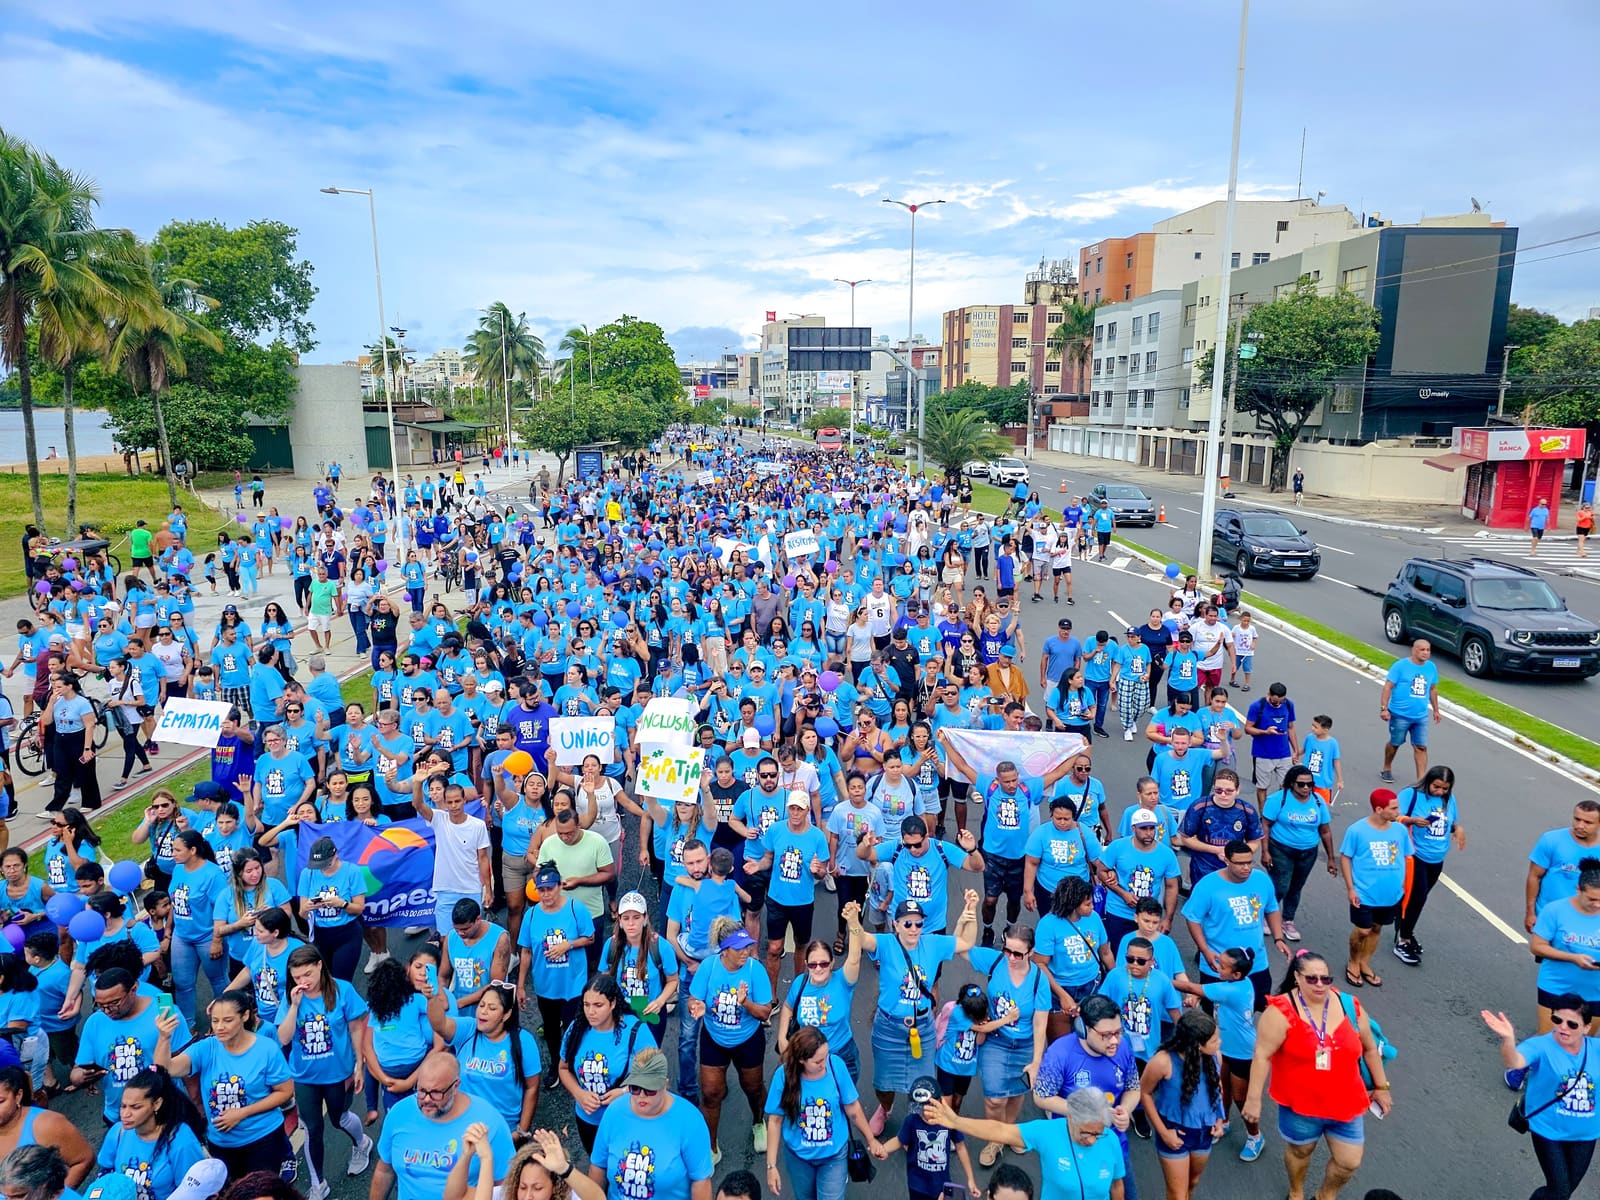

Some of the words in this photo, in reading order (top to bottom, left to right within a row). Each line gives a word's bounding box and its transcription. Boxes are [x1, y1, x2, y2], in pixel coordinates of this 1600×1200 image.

[972, 312, 998, 320] HOTEL
[876, 609, 884, 618] 6
[161, 711, 220, 731] EMPATIA
[561, 727, 610, 749] UNIÃO
[269, 772, 282, 781] EM
[1174, 774, 1188, 782] EM
[269, 780, 282, 788] PA
[268, 787, 283, 795] TIA
[1001, 800, 1015, 809] EM
[762, 812, 775, 821] EM
[1001, 808, 1015, 817] PA
[1001, 816, 1017, 825] TIA
[1429, 827, 1445, 836] TIA
[1050, 839, 1068, 848] RES
[1369, 841, 1388, 851] RES
[785, 852, 800, 861] EM
[1052, 847, 1068, 856] PEI
[1371, 850, 1389, 858] PEI
[50, 860, 61, 869] EM
[1054, 855, 1068, 864] TO
[1374, 857, 1390, 866] TO
[785, 861, 799, 870] PA
[51, 868, 62, 876] PA
[783, 869, 800, 878] TIA
[911, 871, 926, 881] EM
[1134, 871, 1150, 881] EM
[50, 875, 65, 884] TIA
[911, 880, 927, 889] PA
[1134, 880, 1150, 889] PA
[174, 889, 187, 898] EM
[911, 888, 929, 897] TIA
[175, 897, 187, 906] PA
[1228, 896, 1248, 908] RES
[174, 905, 189, 916] TIA
[319, 907, 337, 917] TIA
[1233, 905, 1250, 917] PEI
[1236, 914, 1253, 925] TO
[1063, 935, 1082, 947] RES
[1067, 944, 1085, 955] PEI
[455, 958, 474, 968] RES
[1070, 954, 1087, 964] TO
[457, 967, 473, 978] PEI
[459, 977, 474, 988] TO
[720, 991, 738, 1005] EM
[801, 996, 817, 1007] RES
[719, 1004, 736, 1014] PA
[801, 1008, 818, 1019] PEI
[718, 1014, 737, 1025] TIA
[1127, 1013, 1145, 1023] PA
[305, 1021, 324, 1032] EM
[306, 1032, 325, 1043] PA
[115, 1044, 136, 1056] EM
[305, 1042, 327, 1053] TIA
[115, 1056, 136, 1068] PA
[465, 1056, 506, 1074] UNIÃO
[583, 1060, 604, 1073] EM
[114, 1068, 139, 1081] TIA
[584, 1073, 604, 1083] PA
[217, 1083, 239, 1095] EM
[584, 1082, 607, 1094] TIA
[218, 1095, 239, 1104] PA
[1562, 1097, 1590, 1111] TIA
[806, 1105, 825, 1117] EM
[807, 1116, 825, 1128] PA
[805, 1127, 827, 1140] TIA
[404, 1149, 453, 1168] UNIÃO
[626, 1152, 649, 1171] EM
[917, 1160, 947, 1172] MICKEY
[624, 1170, 646, 1184] PA
[622, 1183, 648, 1198] TIA
